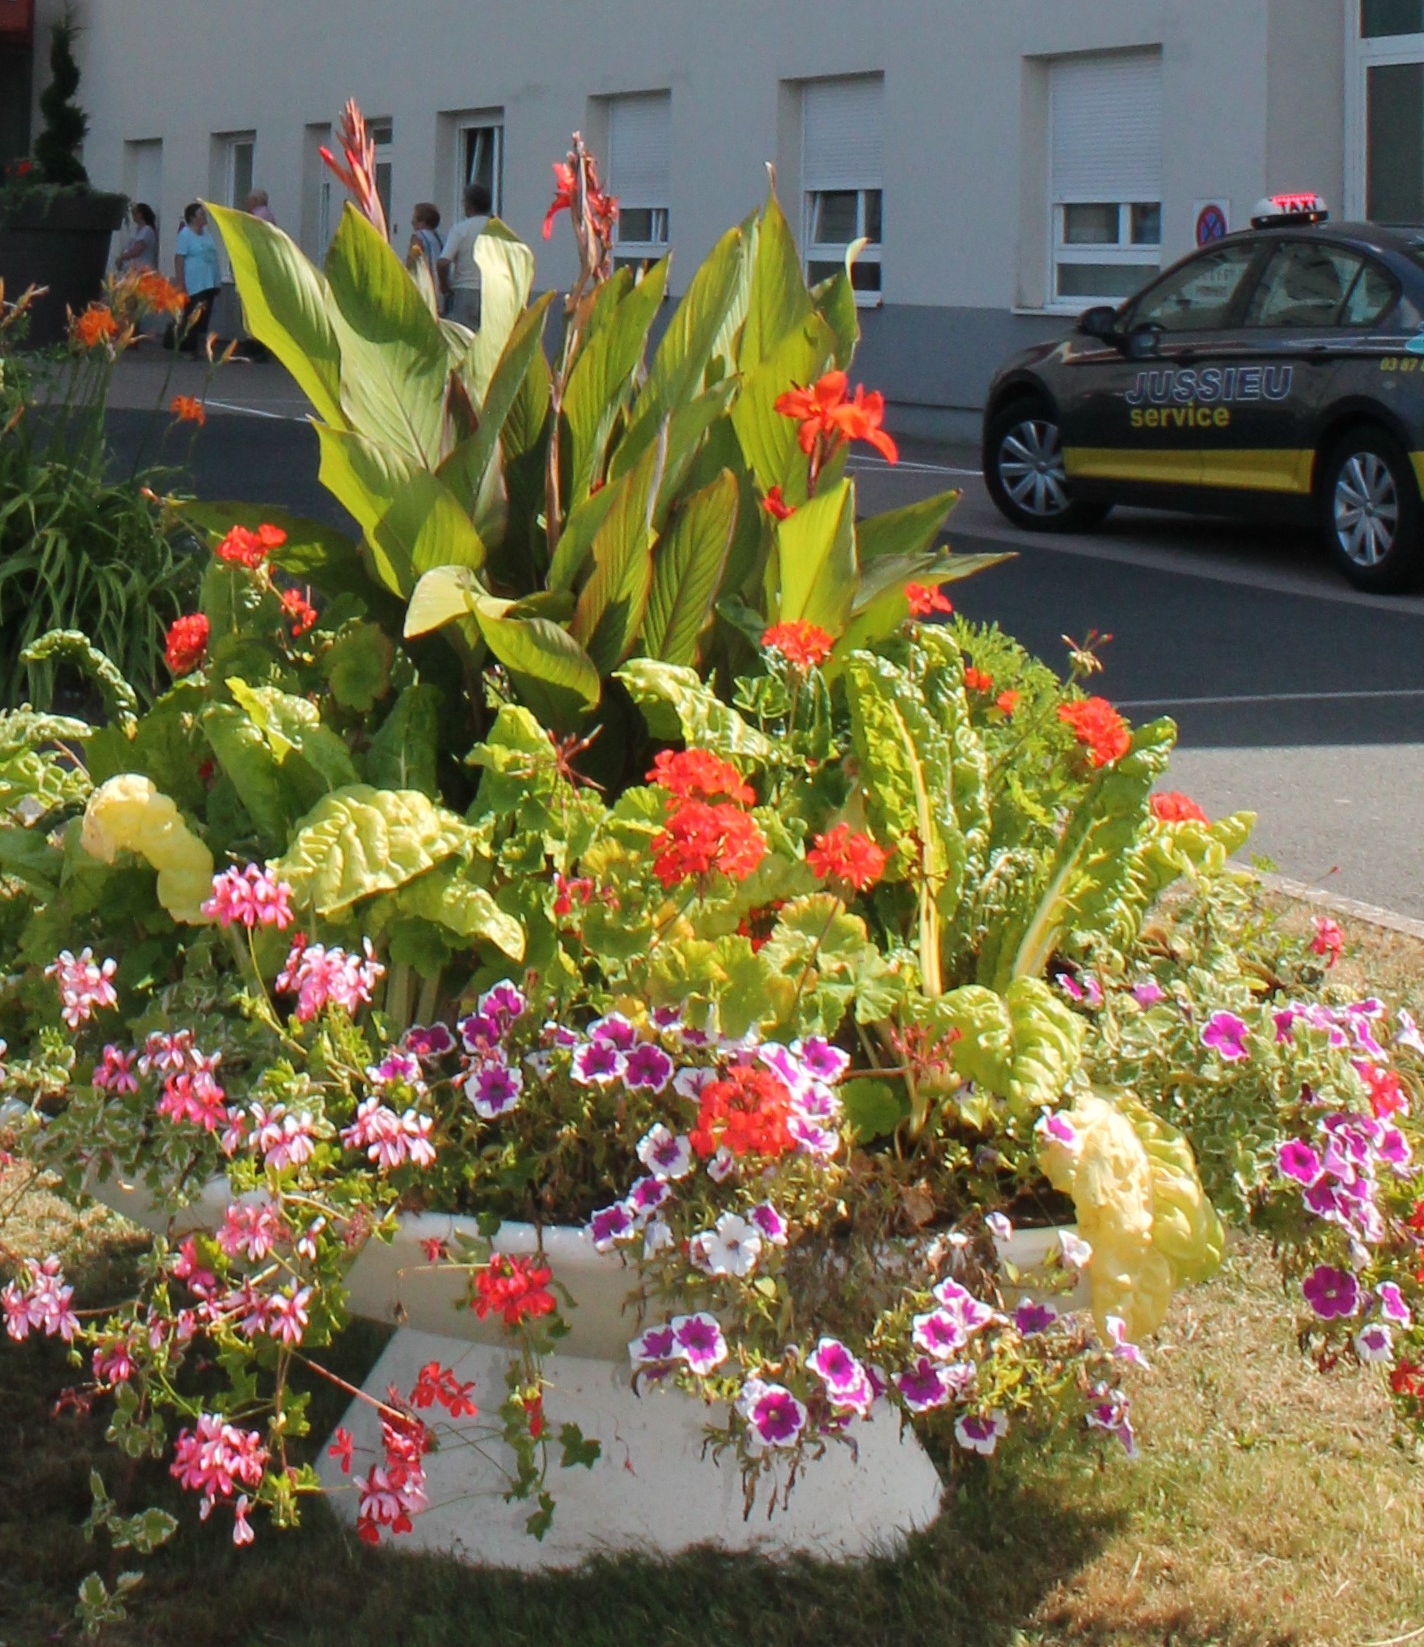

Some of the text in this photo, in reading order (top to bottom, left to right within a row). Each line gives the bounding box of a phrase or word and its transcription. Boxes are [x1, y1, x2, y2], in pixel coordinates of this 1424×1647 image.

[1277, 201, 1317, 214] TAXI
[1126, 366, 1293, 404] JUSSIEU
[1130, 401, 1231, 427] service
